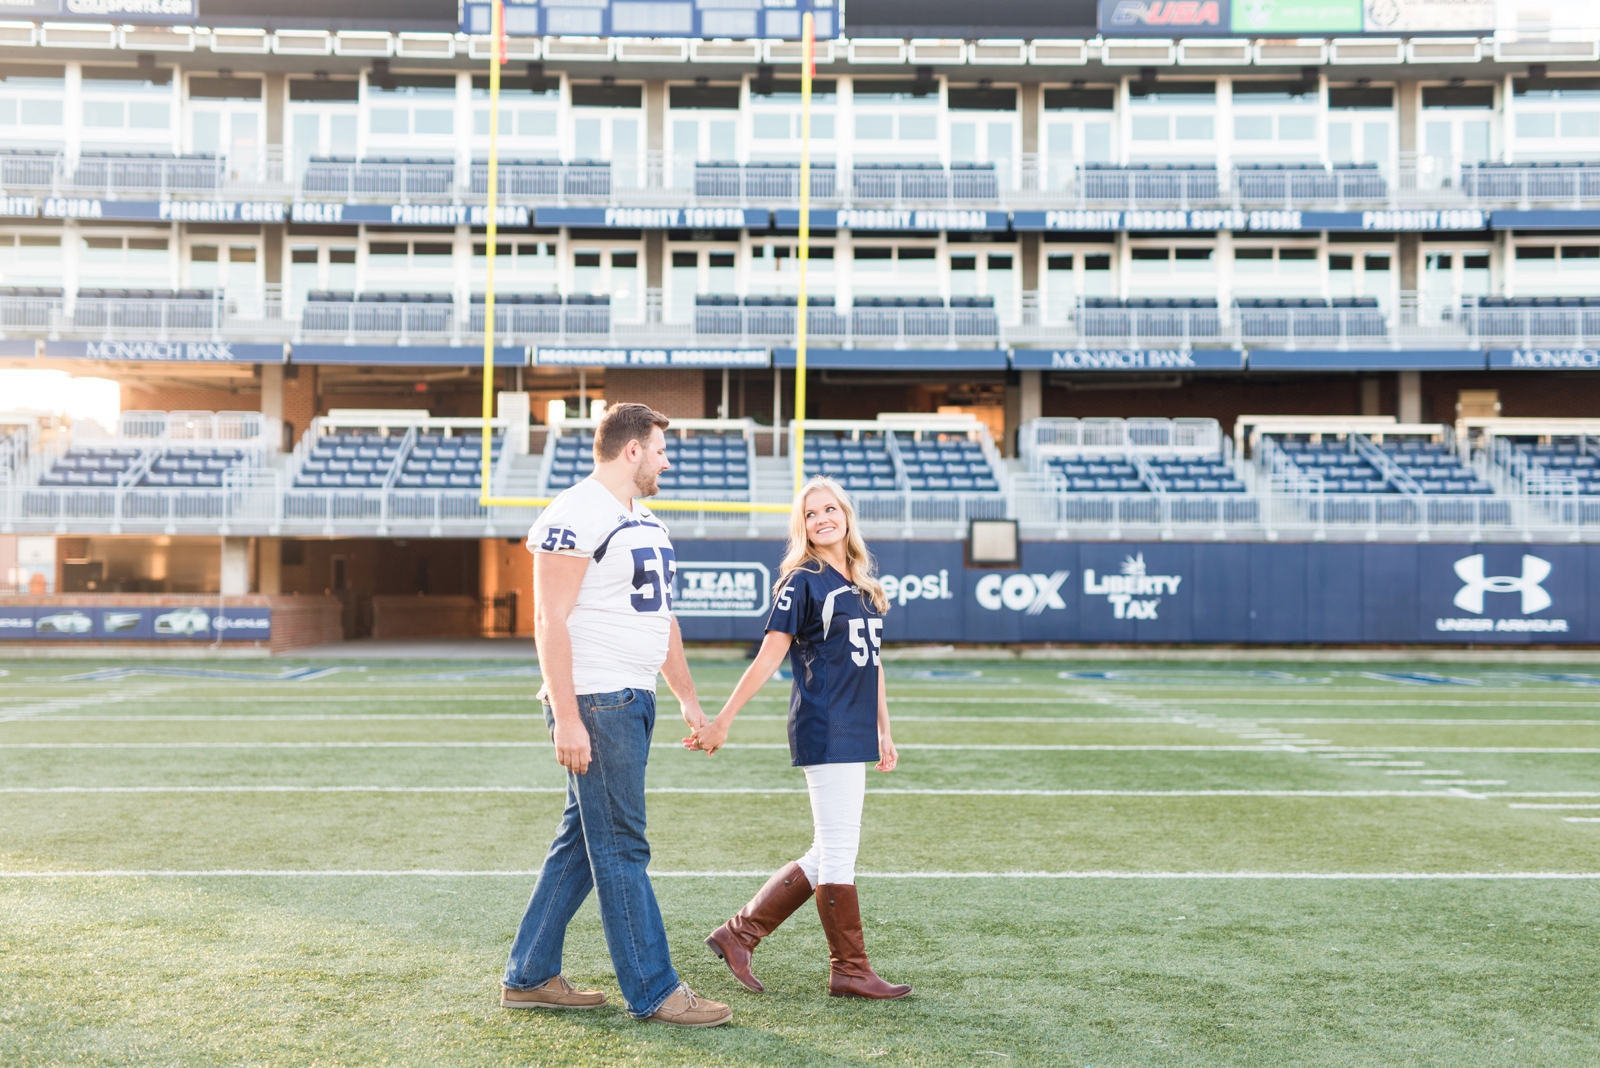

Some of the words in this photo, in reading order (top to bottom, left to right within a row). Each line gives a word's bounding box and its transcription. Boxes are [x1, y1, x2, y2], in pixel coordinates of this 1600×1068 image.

[44, 198, 102, 218] ACURA
[159, 201, 237, 221] PRIORITY
[391, 205, 467, 225] PRIORITY
[605, 208, 679, 228] PRIORITY
[684, 208, 745, 228] TOYOTA
[837, 210, 911, 229] PRIORITY
[914, 210, 987, 230] HYUNDAI
[1045, 210, 1120, 230] PRIORITY
[1190, 210, 1245, 230] SUPER
[1249, 210, 1302, 230] STORE
[1362, 210, 1438, 230] PRIORITY
[1440, 210, 1482, 229] FORD
[86, 341, 183, 360] MONARCH
[186, 341, 235, 361] BANK
[538, 349, 627, 364] MONARCH
[629, 349, 667, 364] FOR
[670, 349, 767, 365] MONARCHS
[1051, 350, 1145, 369] MONARCH
[1148, 350, 1196, 368] BANK
[541, 527, 577, 551] 55
[683, 571, 755, 590] TEAM
[878, 568, 954, 606] epsi
[975, 569, 1070, 616] COX
[1435, 617, 1494, 632] UNDER
[1494, 618, 1569, 632] ARMOUR
[848, 618, 883, 667] 55
